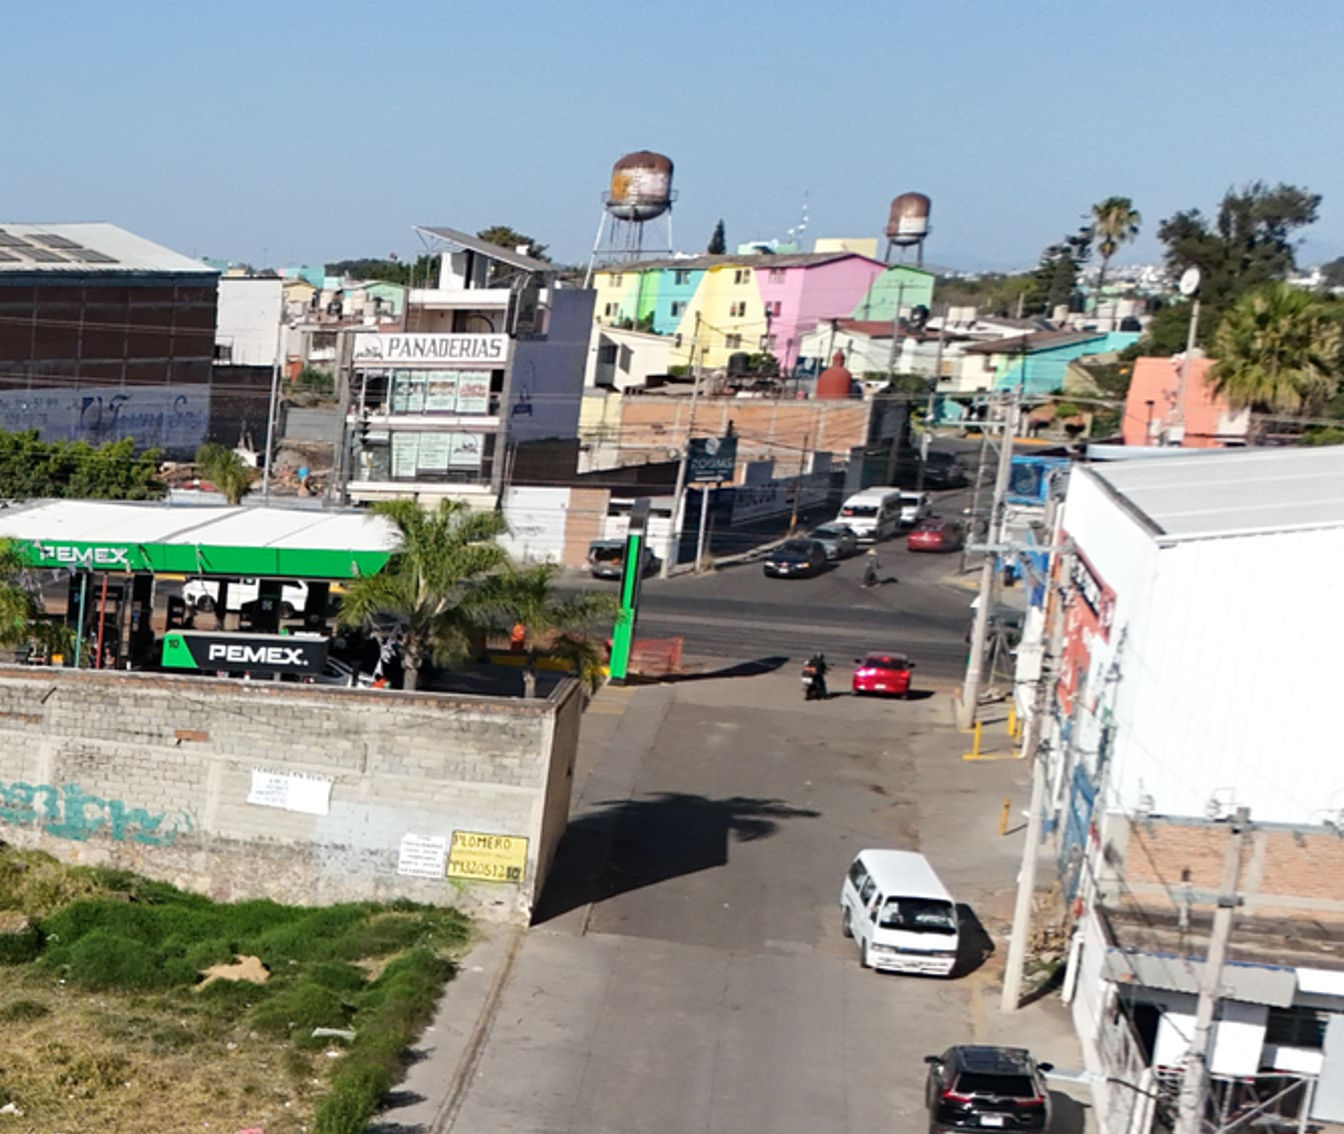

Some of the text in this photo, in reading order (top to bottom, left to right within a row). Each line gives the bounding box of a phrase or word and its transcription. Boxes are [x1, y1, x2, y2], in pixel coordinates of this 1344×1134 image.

[387, 336, 503, 359] PANADERIAS
[690, 457, 733, 472] ROOMS
[452, 834, 512, 850] PLOMERO
